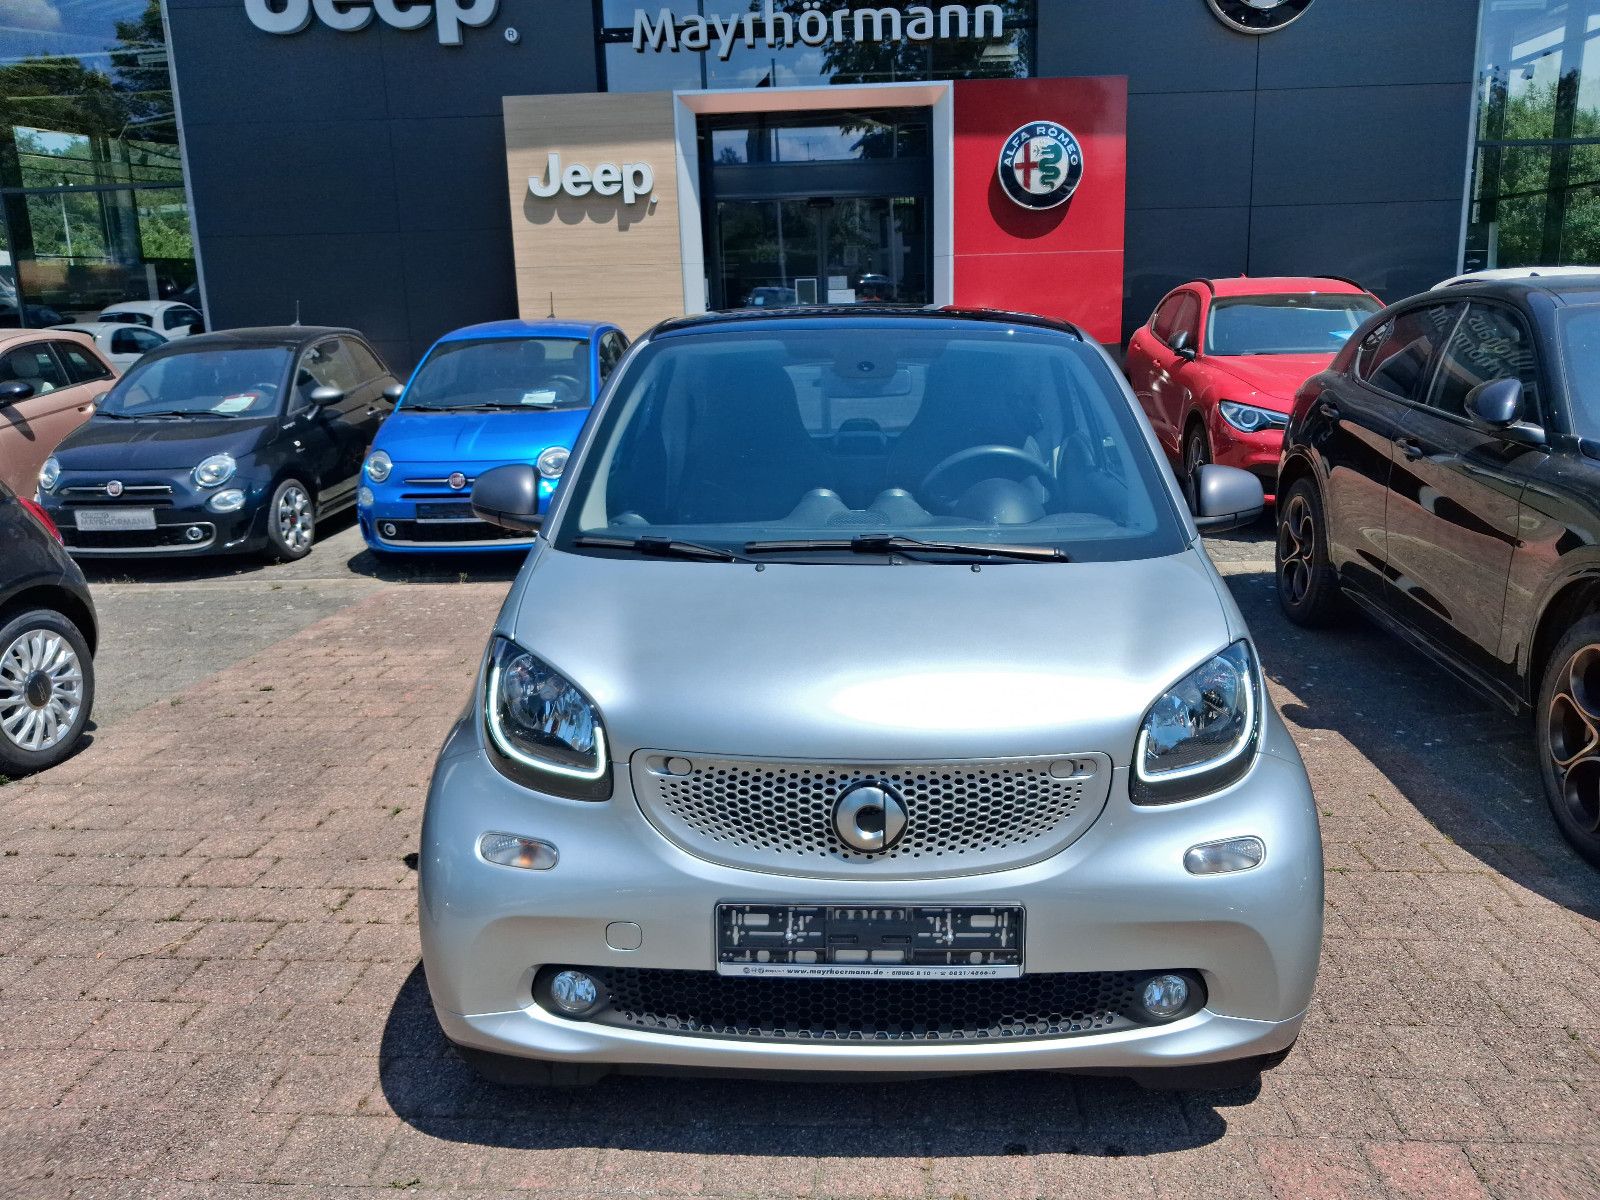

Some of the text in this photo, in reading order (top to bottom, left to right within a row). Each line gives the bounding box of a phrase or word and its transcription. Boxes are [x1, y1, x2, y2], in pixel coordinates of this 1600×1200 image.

[632, 0, 1004, 58] Mayrhörmann
[1003, 125, 1079, 168] ALFA ROMEO
[527, 151, 655, 204] Jeep
